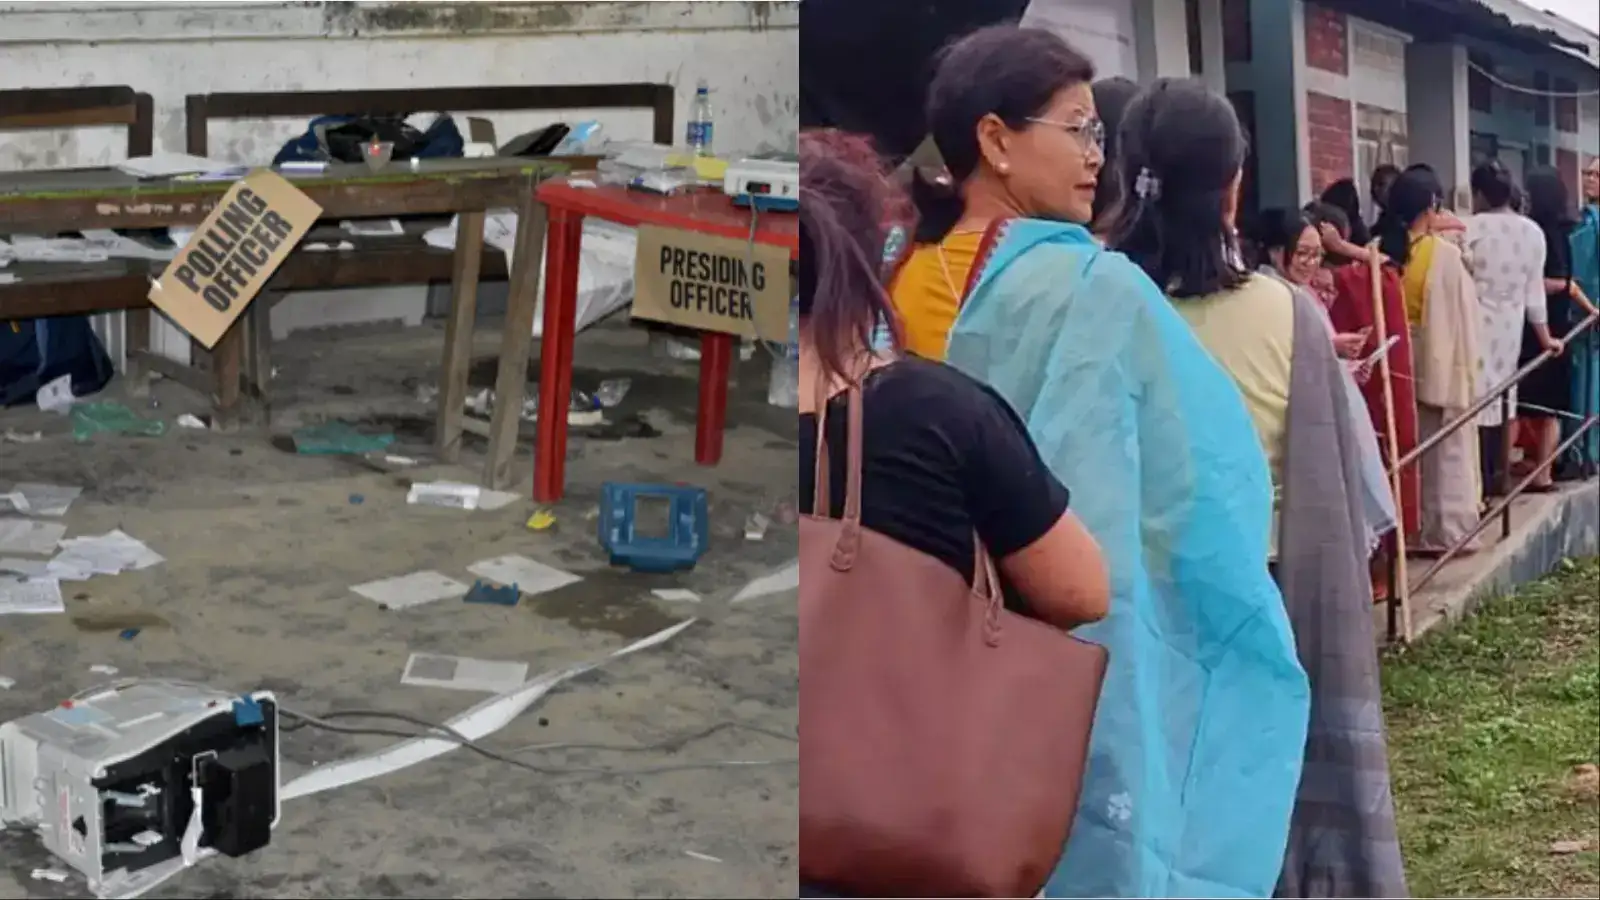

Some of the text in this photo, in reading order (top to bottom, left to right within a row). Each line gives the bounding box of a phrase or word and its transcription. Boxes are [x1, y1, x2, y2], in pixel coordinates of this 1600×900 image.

[174, 187, 268, 293] POLLING
[202, 210, 293, 313] OFFICER
[660, 245, 765, 291] PRESIDING
[670, 279, 753, 320] OFFICER
